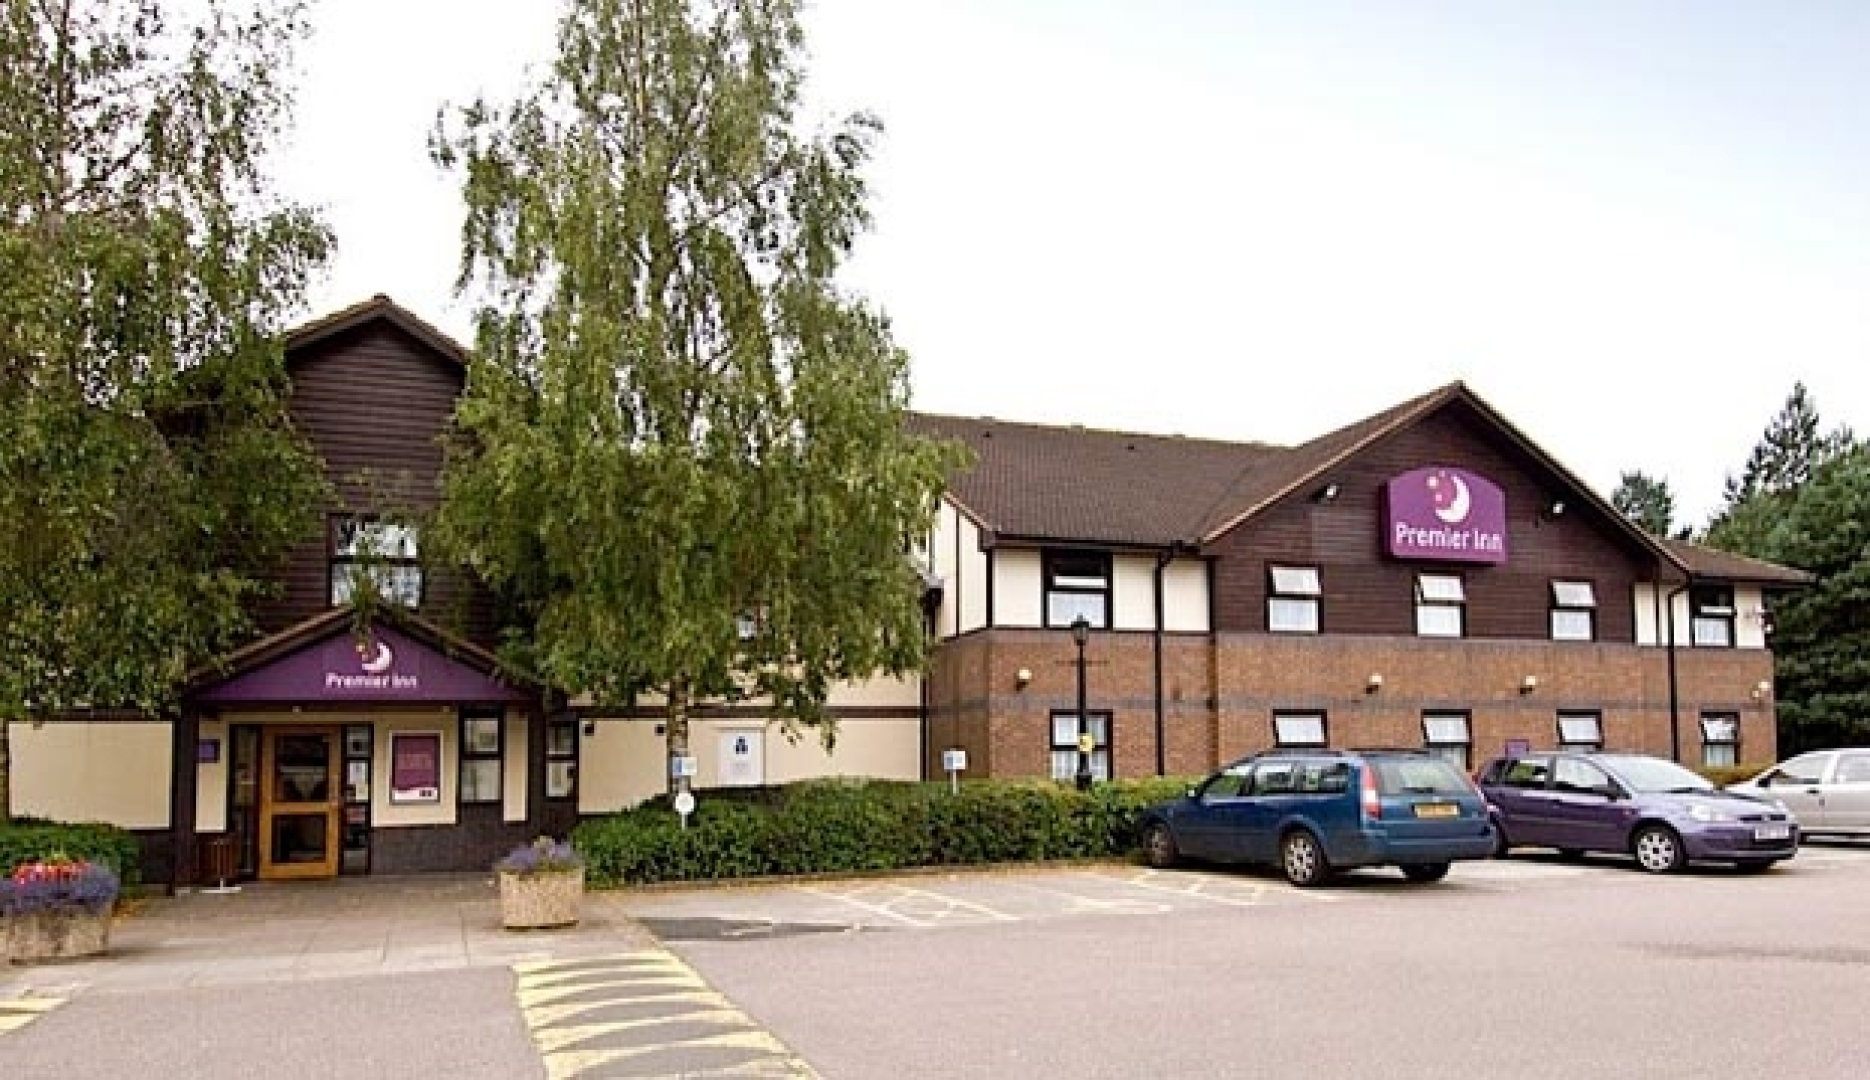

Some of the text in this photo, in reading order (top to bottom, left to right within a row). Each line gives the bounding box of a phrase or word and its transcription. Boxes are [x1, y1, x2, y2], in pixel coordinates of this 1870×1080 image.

[1396, 522, 1502, 552] Premier Inn
[326, 673, 417, 688] Premier Inn
